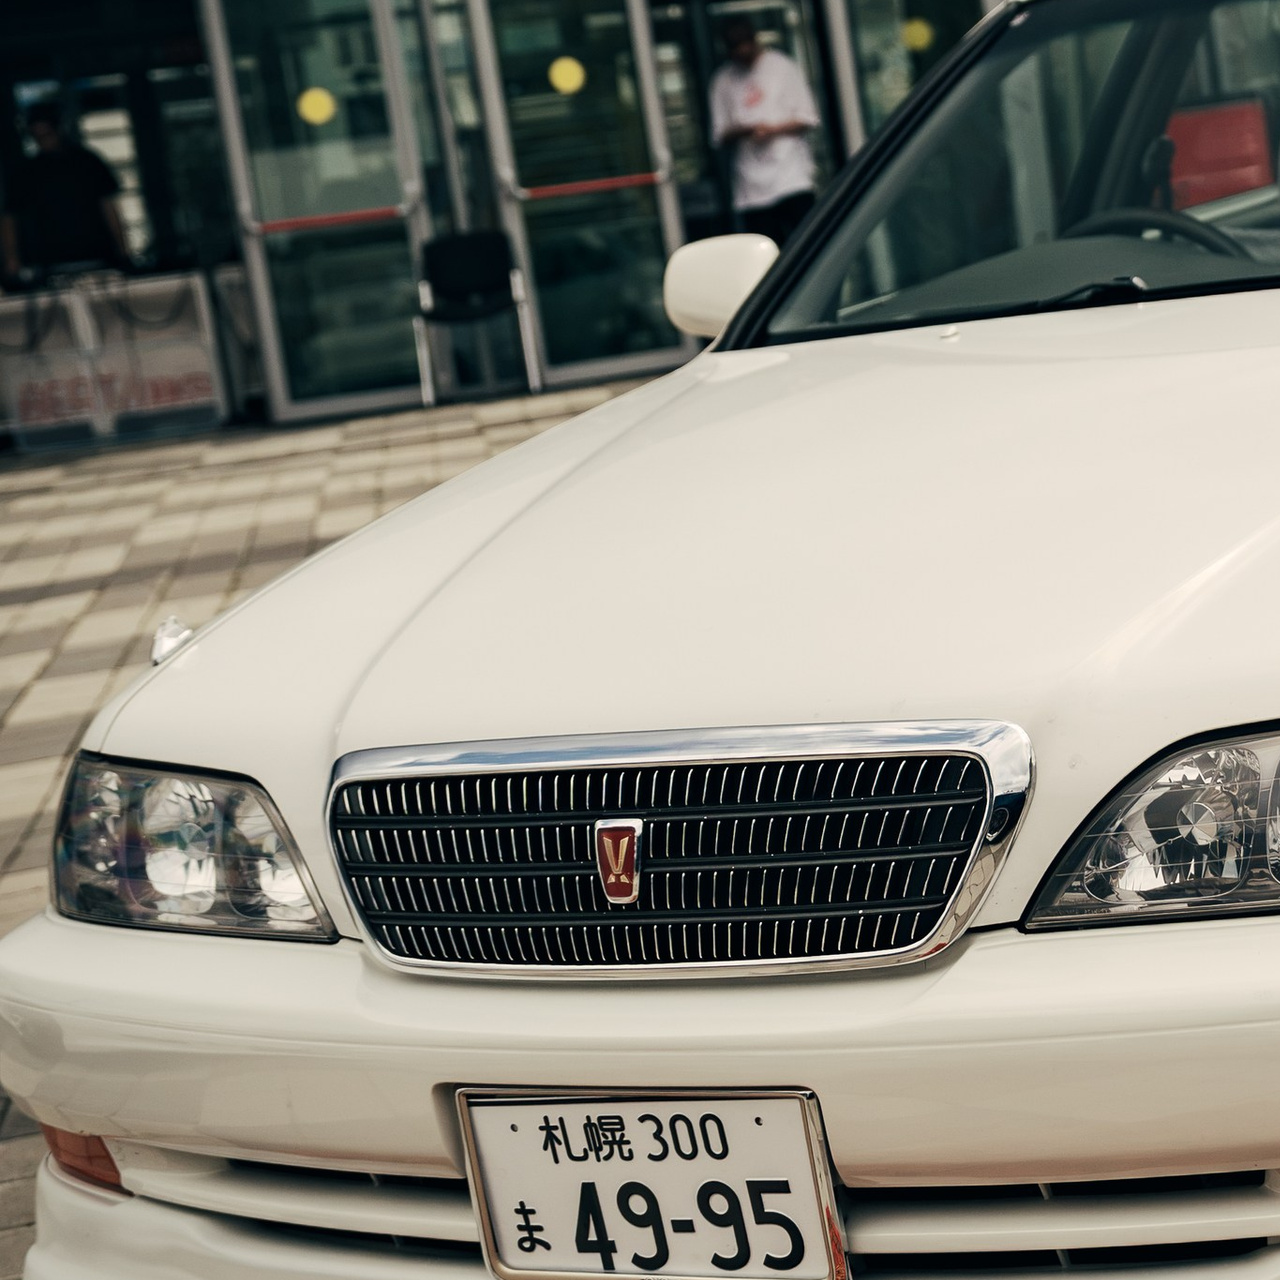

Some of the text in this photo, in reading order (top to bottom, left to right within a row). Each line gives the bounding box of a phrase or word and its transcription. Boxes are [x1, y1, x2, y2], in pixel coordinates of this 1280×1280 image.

[539, 1113, 729, 1163] 札幌 300
[514, 1179, 805, 1271] ま 49-95
